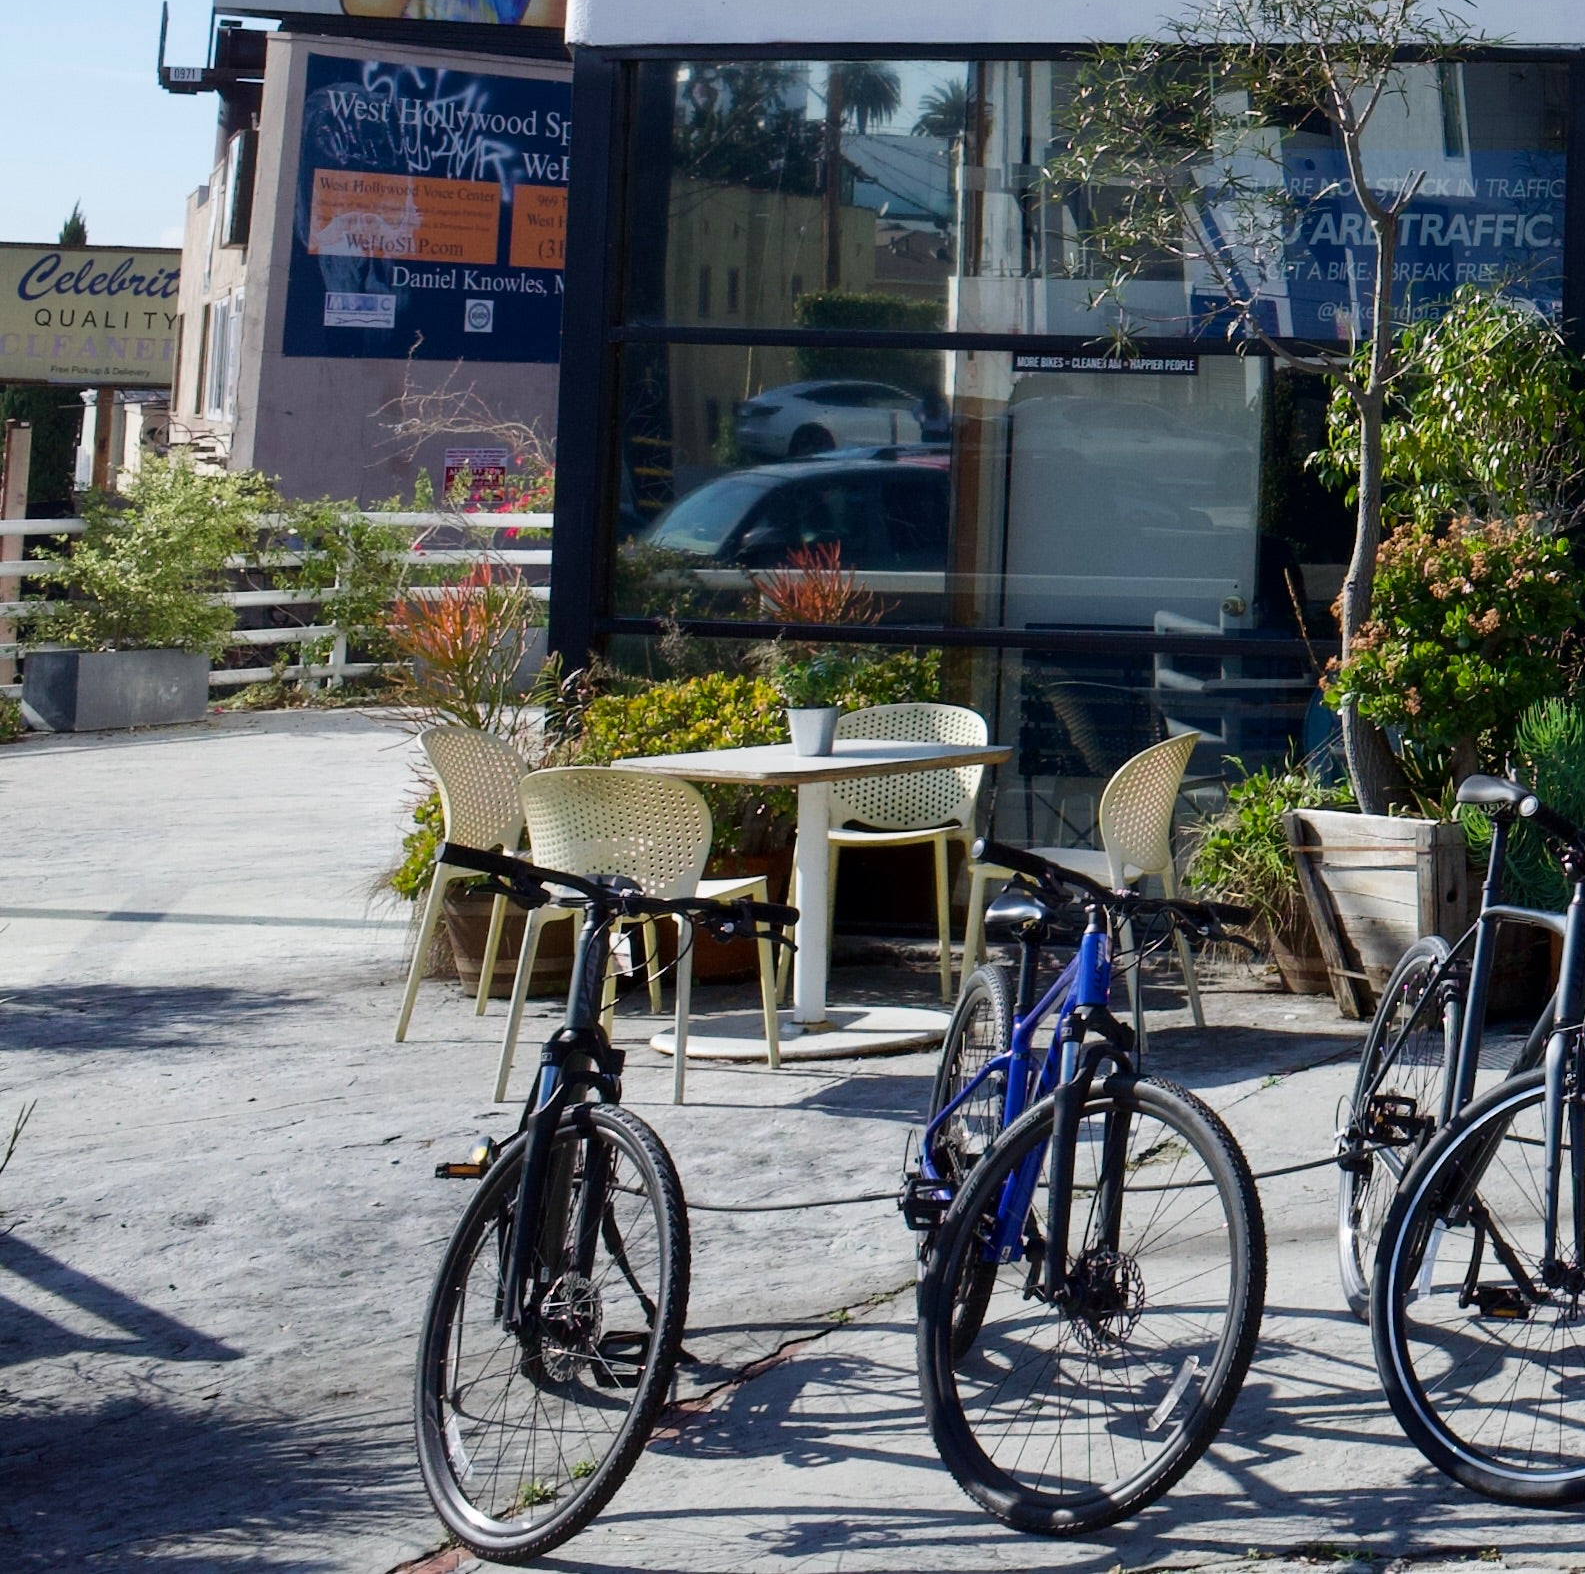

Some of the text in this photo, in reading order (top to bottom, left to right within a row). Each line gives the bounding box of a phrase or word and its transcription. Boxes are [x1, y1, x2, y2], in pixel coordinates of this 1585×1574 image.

[174, 68, 195, 80] 0971
[327, 90, 391, 123] West
[399, 97, 538, 136] Hollywood
[320, 177, 495, 204] West Hollywood Voice Center
[1319, 177, 1370, 198] NO
[1457, 178, 1479, 198] IN
[527, 214, 555, 227] West
[1309, 212, 1378, 246] ARE
[1398, 212, 1562, 247] TRAFFIC.
[346, 233, 464, 258] WeHoSLP.com
[391, 266, 456, 290] Daniel
[464, 272, 548, 296] Knowles,
[1307, 262, 1322, 281] A
[34, 308, 178, 330] QUALITY
[51, 365, 69, 374] Free
[1017, 356, 1039, 367] MORE
[1040, 357, 1063, 368] BIKES
[1130, 359, 1162, 370] HAPPIER
[1165, 359, 1195, 371] PEOPLE
